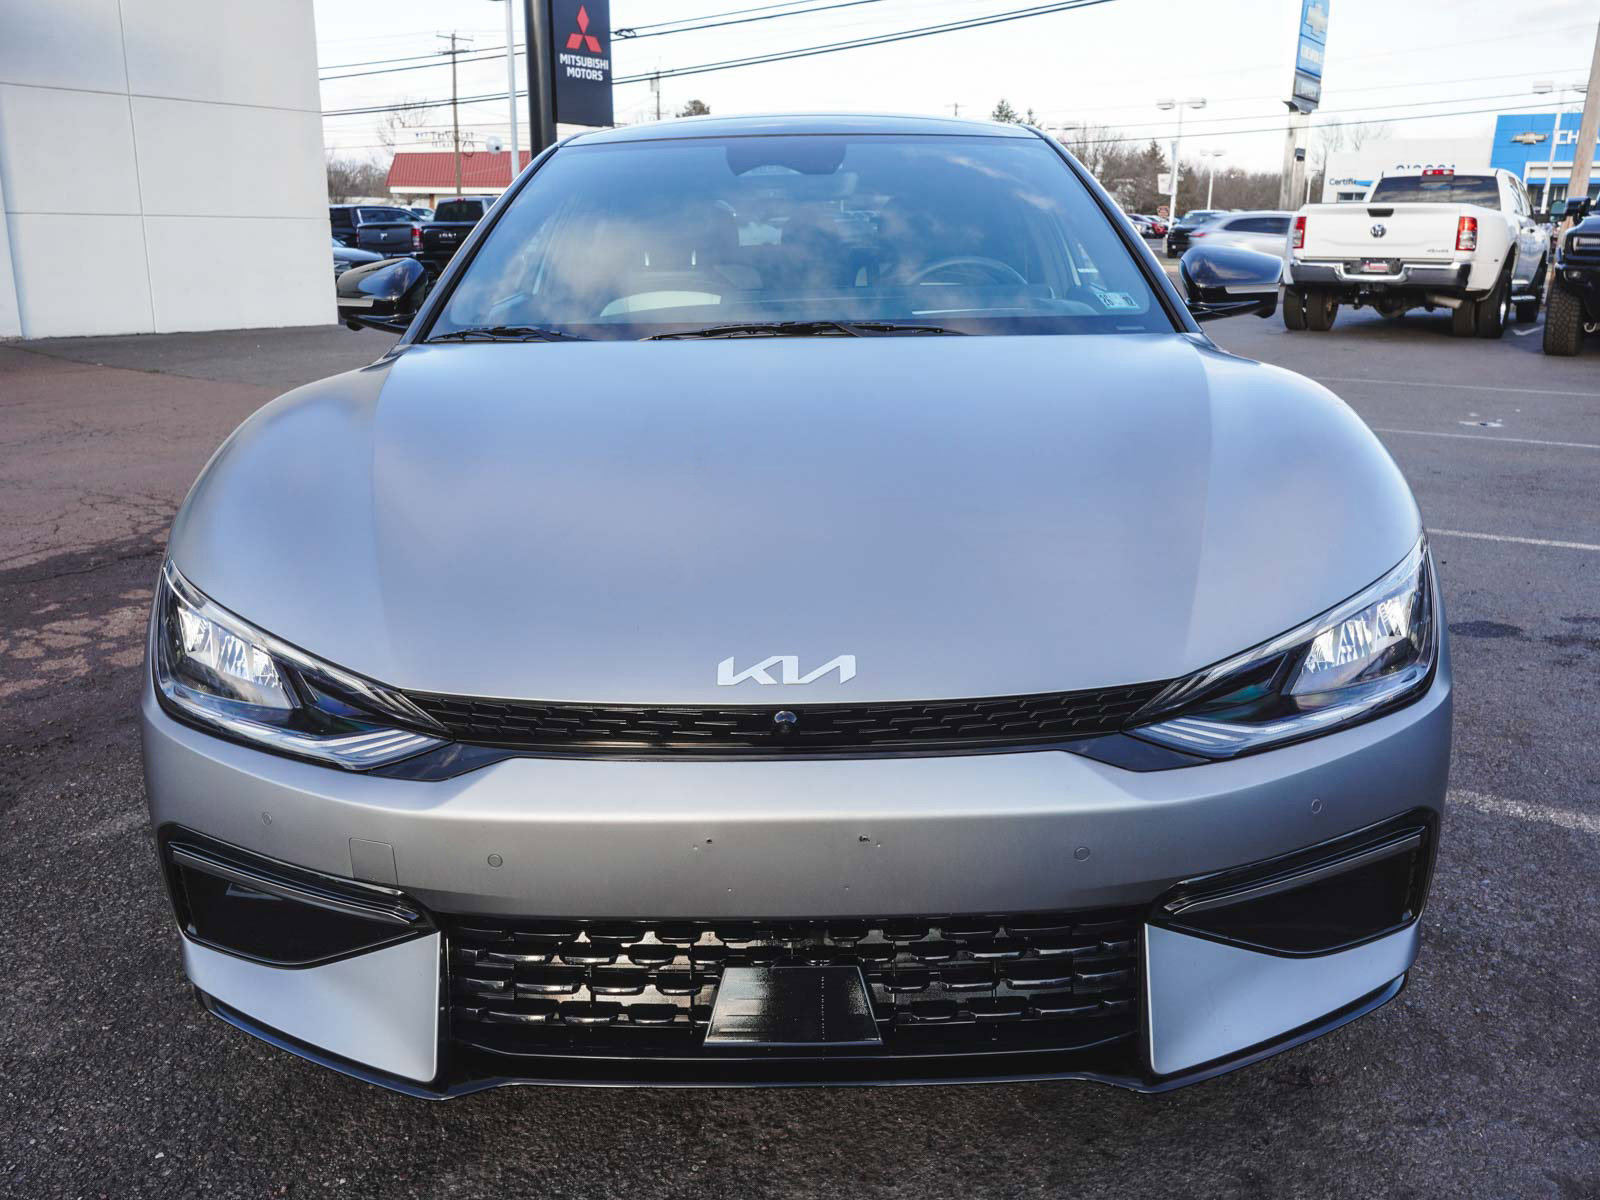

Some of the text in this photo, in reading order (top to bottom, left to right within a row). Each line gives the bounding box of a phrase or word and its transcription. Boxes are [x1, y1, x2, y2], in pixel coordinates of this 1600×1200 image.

[559, 53, 609, 70] MITSUBISHI
[566, 66, 604, 81] MOTORS
[717, 654, 856, 686] KIA
